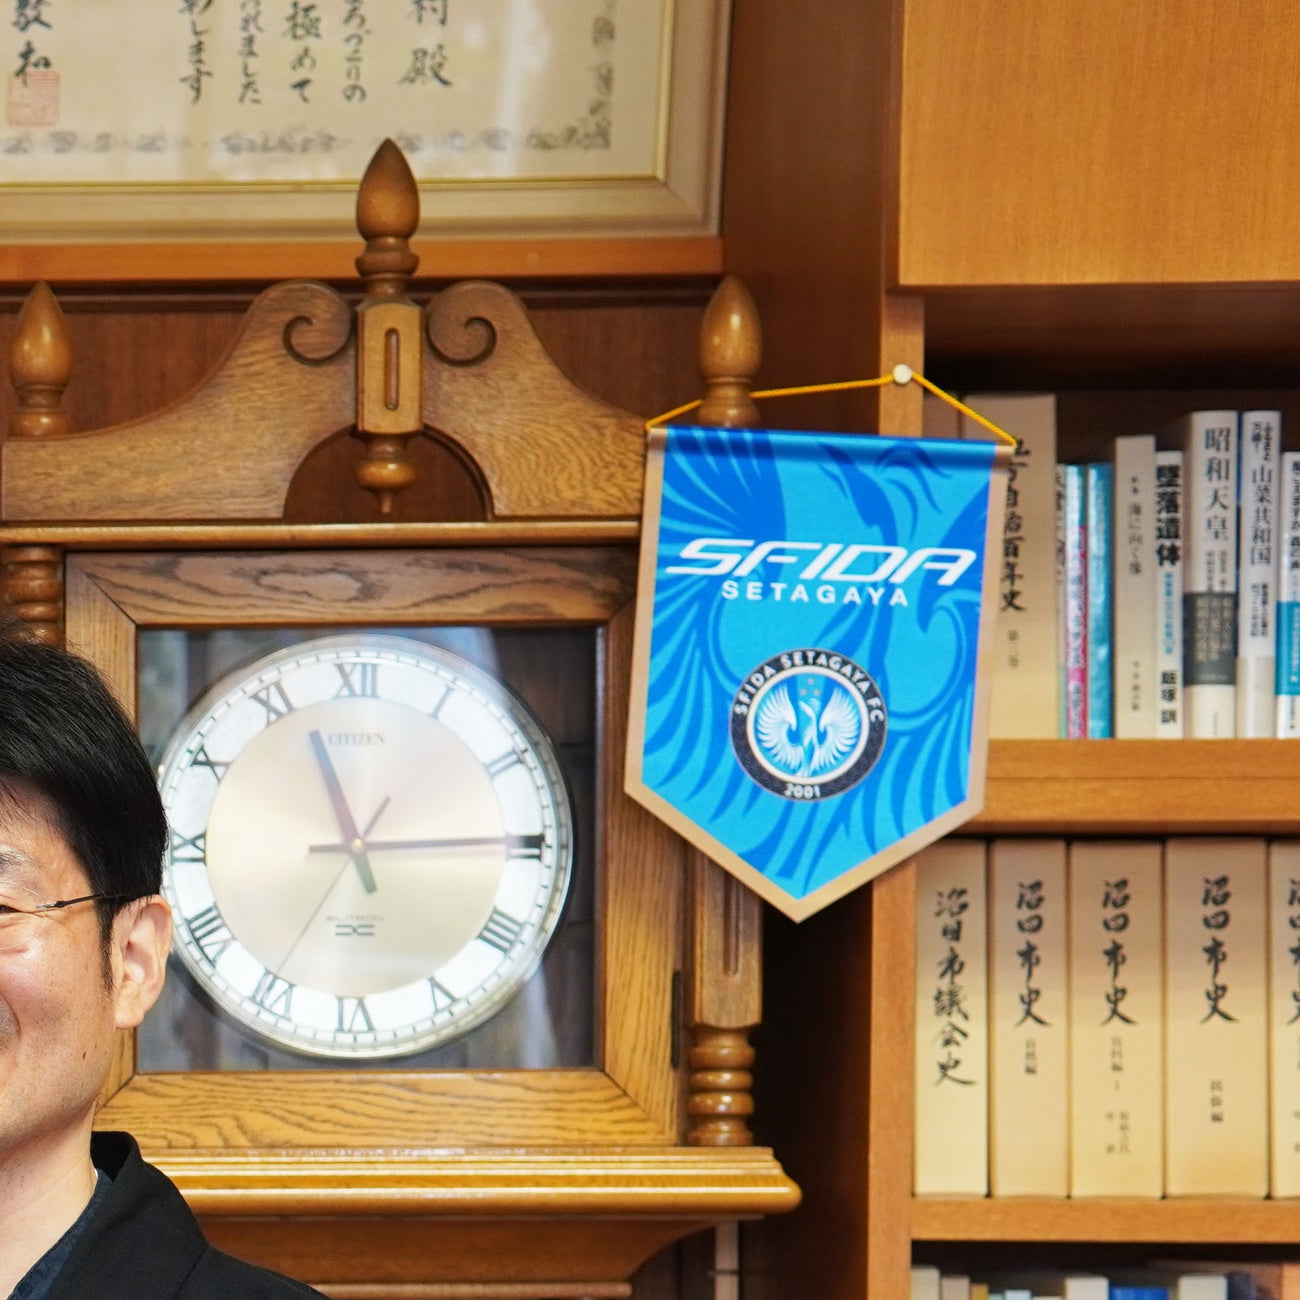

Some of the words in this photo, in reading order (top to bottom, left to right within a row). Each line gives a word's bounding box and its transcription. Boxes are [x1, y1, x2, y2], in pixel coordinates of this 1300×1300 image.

[1204, 426, 1232, 542] 昭和天皇
[665, 538, 977, 586] SFIDA
[721, 580, 908, 606] SETAGAYA
[248, 680, 295, 727] XI
[332, 663, 379, 699] XII
[734, 664, 777, 715] SFIDA
[779, 651, 871, 694] SETAGAYA
[866, 697, 885, 723] FC
[327, 732, 385, 746] CITIZEN
[190, 745, 231, 782] X
[784, 783, 821, 799] 2001
[170, 830, 208, 865] IX
[184, 905, 233, 968] VIII
[1014, 879, 1052, 1028] 沼田市史
[1100, 878, 1138, 1026] 沼田市史
[1200, 875, 1240, 1025] 沼田市史
[336, 996, 374, 1032] VI
